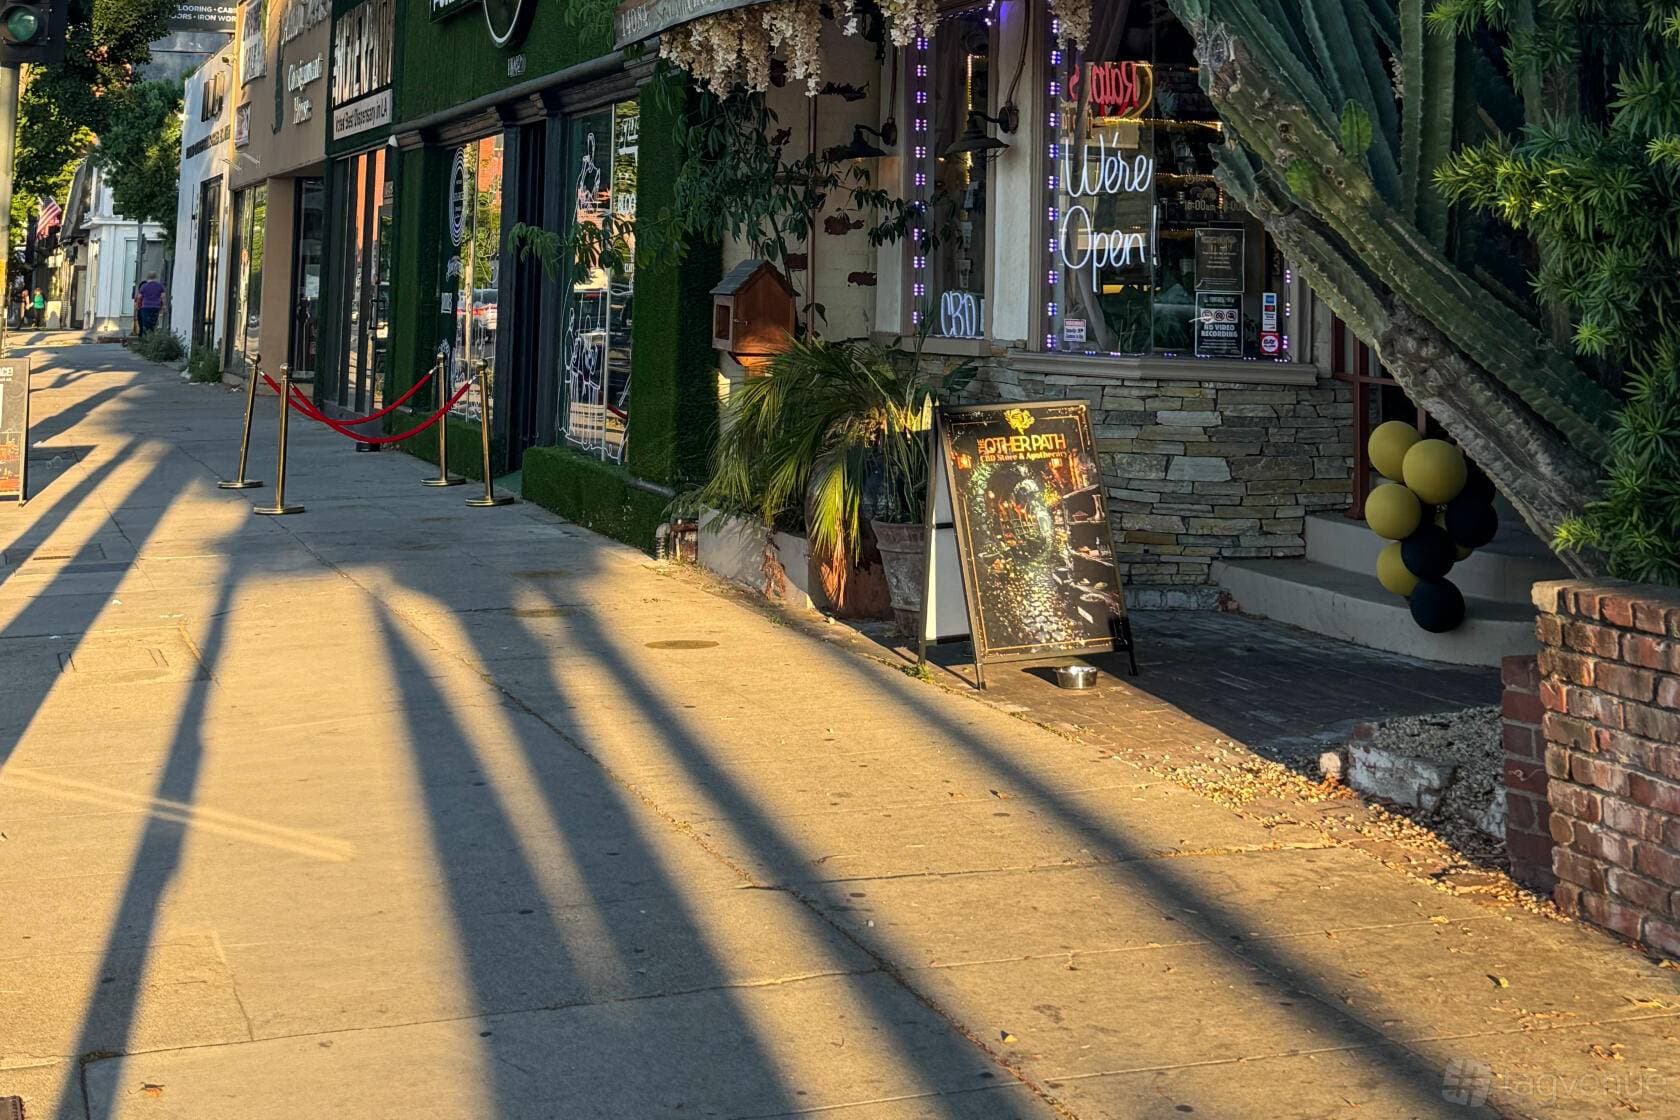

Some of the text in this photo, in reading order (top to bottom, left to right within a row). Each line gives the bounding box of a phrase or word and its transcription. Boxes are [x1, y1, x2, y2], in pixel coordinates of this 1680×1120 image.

[173, 4, 212, 13] LOORING
[197, 13, 216, 21] IRON
[941, 291, 976, 337] CBD
[1201, 330, 1238, 338] RECORDING
[985, 435, 1032, 455] OTHER
[1031, 432, 1067, 452] PATH
[997, 453, 1018, 462] Store
